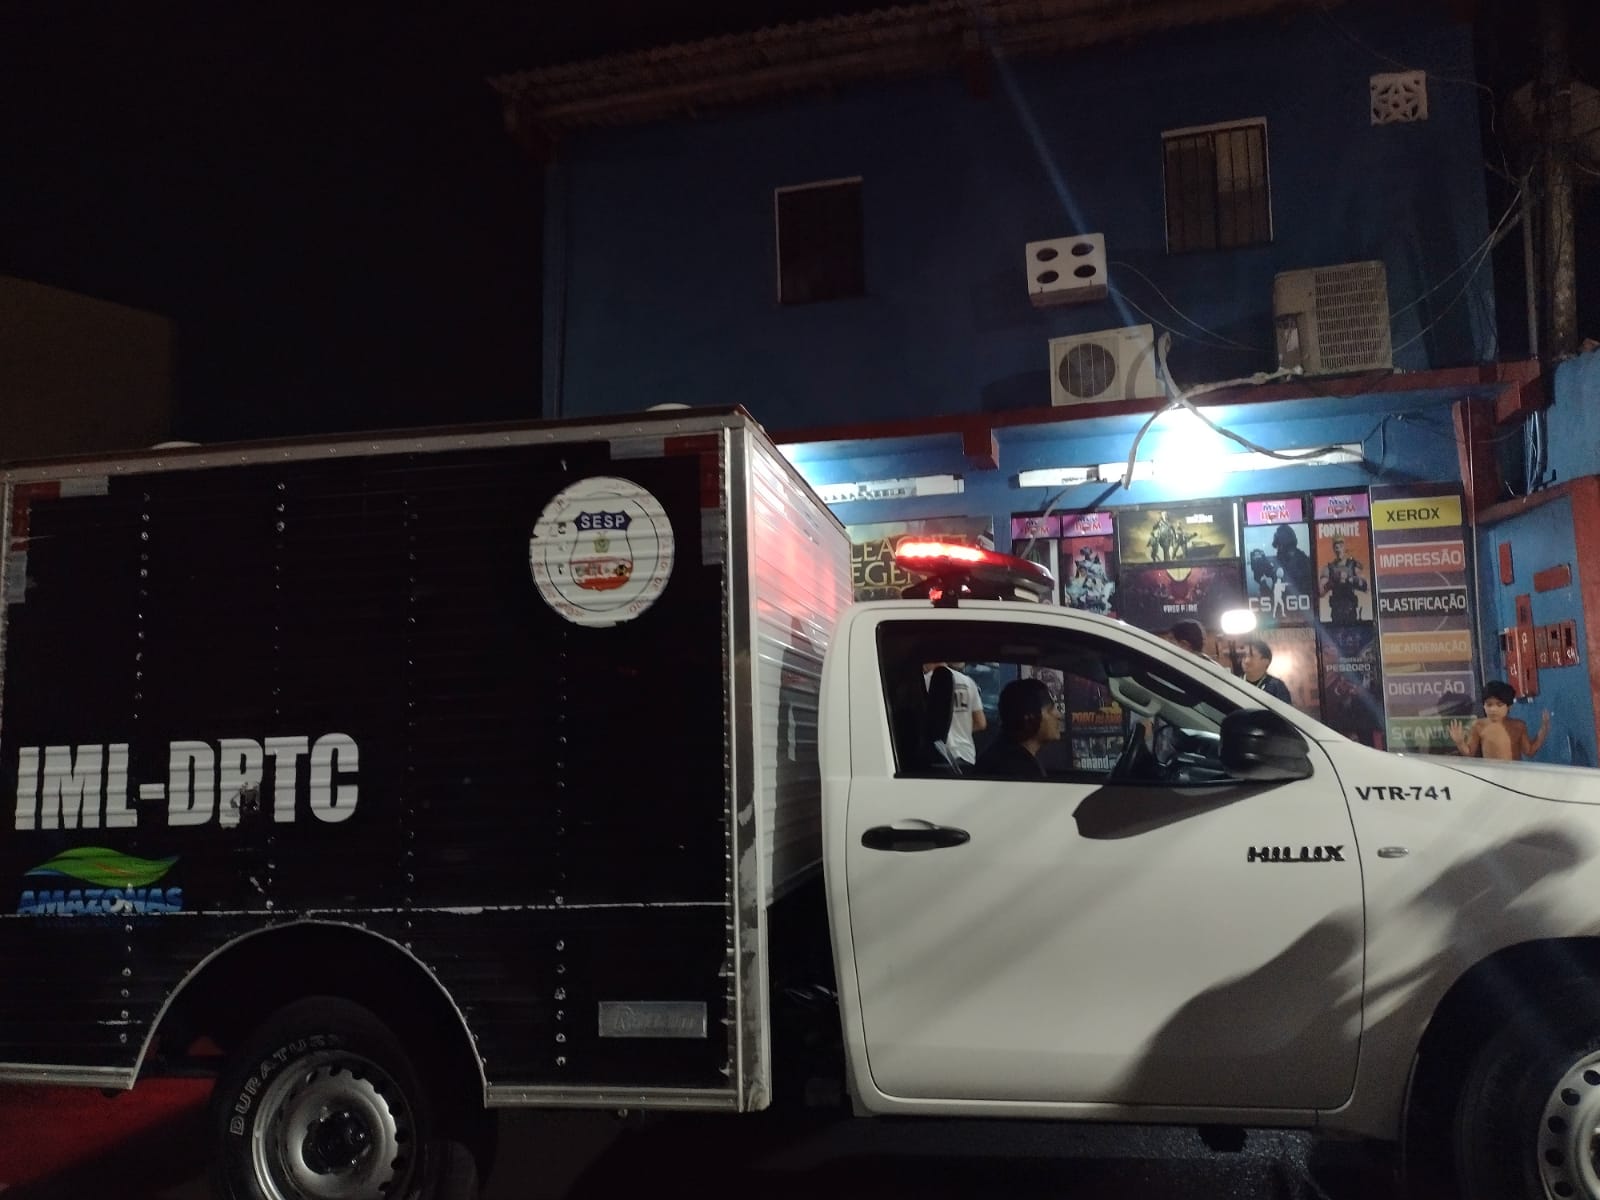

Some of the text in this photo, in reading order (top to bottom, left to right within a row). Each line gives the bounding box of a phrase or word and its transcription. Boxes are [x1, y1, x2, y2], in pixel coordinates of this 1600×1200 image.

[580, 514, 626, 529] SESP
[1386, 507, 1440, 523] XEROX
[1318, 522, 1360, 539] FORTNITE
[1379, 549, 1461, 569] IMPRESSÃO
[1248, 595, 1310, 612] CS GO
[1380, 593, 1466, 613] PLASTIFICAÇÃO
[1325, 662, 1371, 673] PES2020
[1388, 679, 1465, 698] DIGITAÇÃO
[1390, 723, 1471, 741] SCANN
[15, 732, 360, 830] IML-DPTC
[1355, 786, 1452, 801] VTR-741
[1247, 845, 1345, 863] HILUX
[16, 886, 185, 914] AMAZONAS
